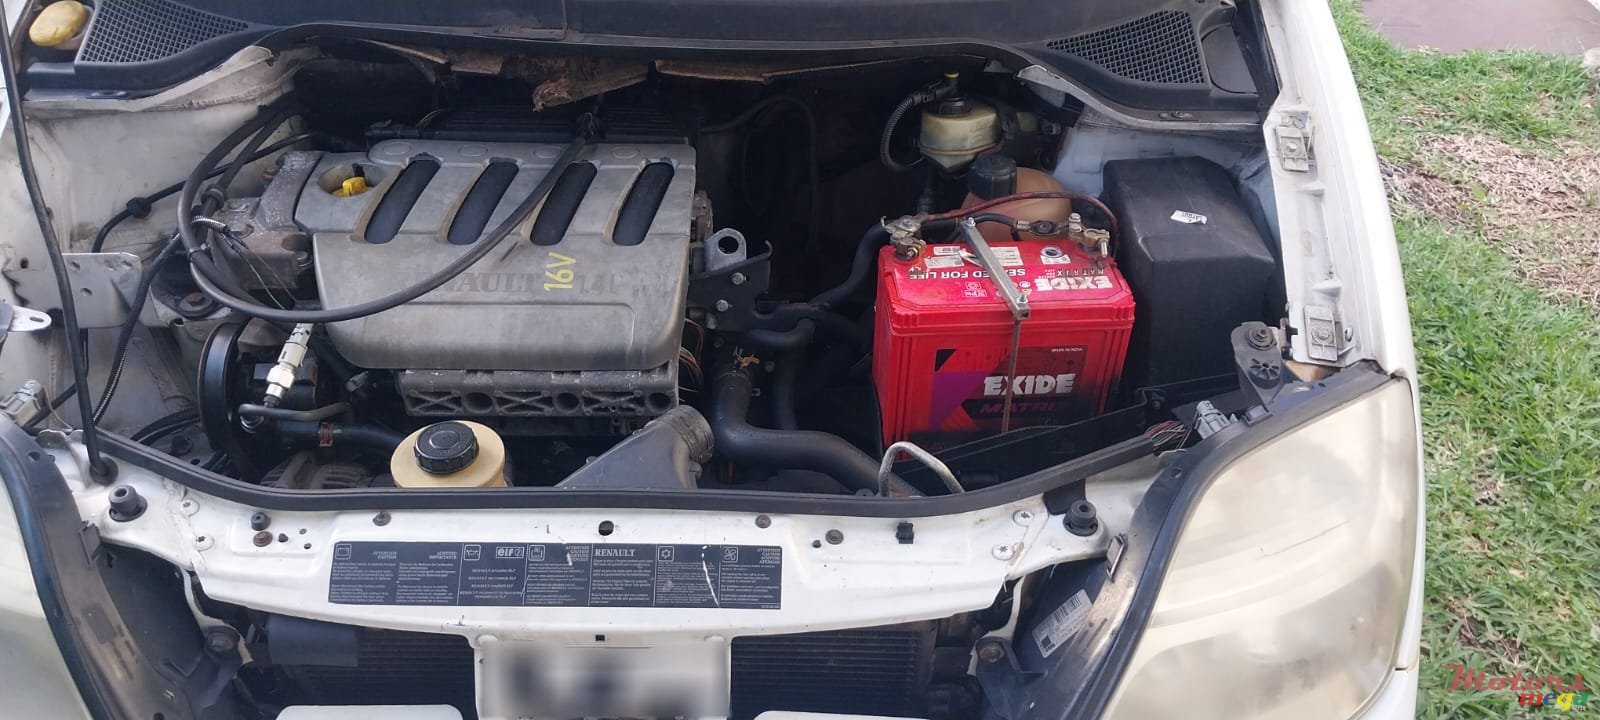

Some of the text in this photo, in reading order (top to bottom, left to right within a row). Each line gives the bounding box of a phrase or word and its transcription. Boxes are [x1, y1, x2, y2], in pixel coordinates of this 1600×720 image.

[544, 251, 577, 292] 16V
[941, 270, 969, 279] FOR
[972, 268, 1026, 278] SEED
[1034, 275, 1114, 292] EXIDE
[983, 373, 1077, 396] EXIDE
[497, 548, 514, 557] elf
[594, 548, 636, 557] RENAULT
